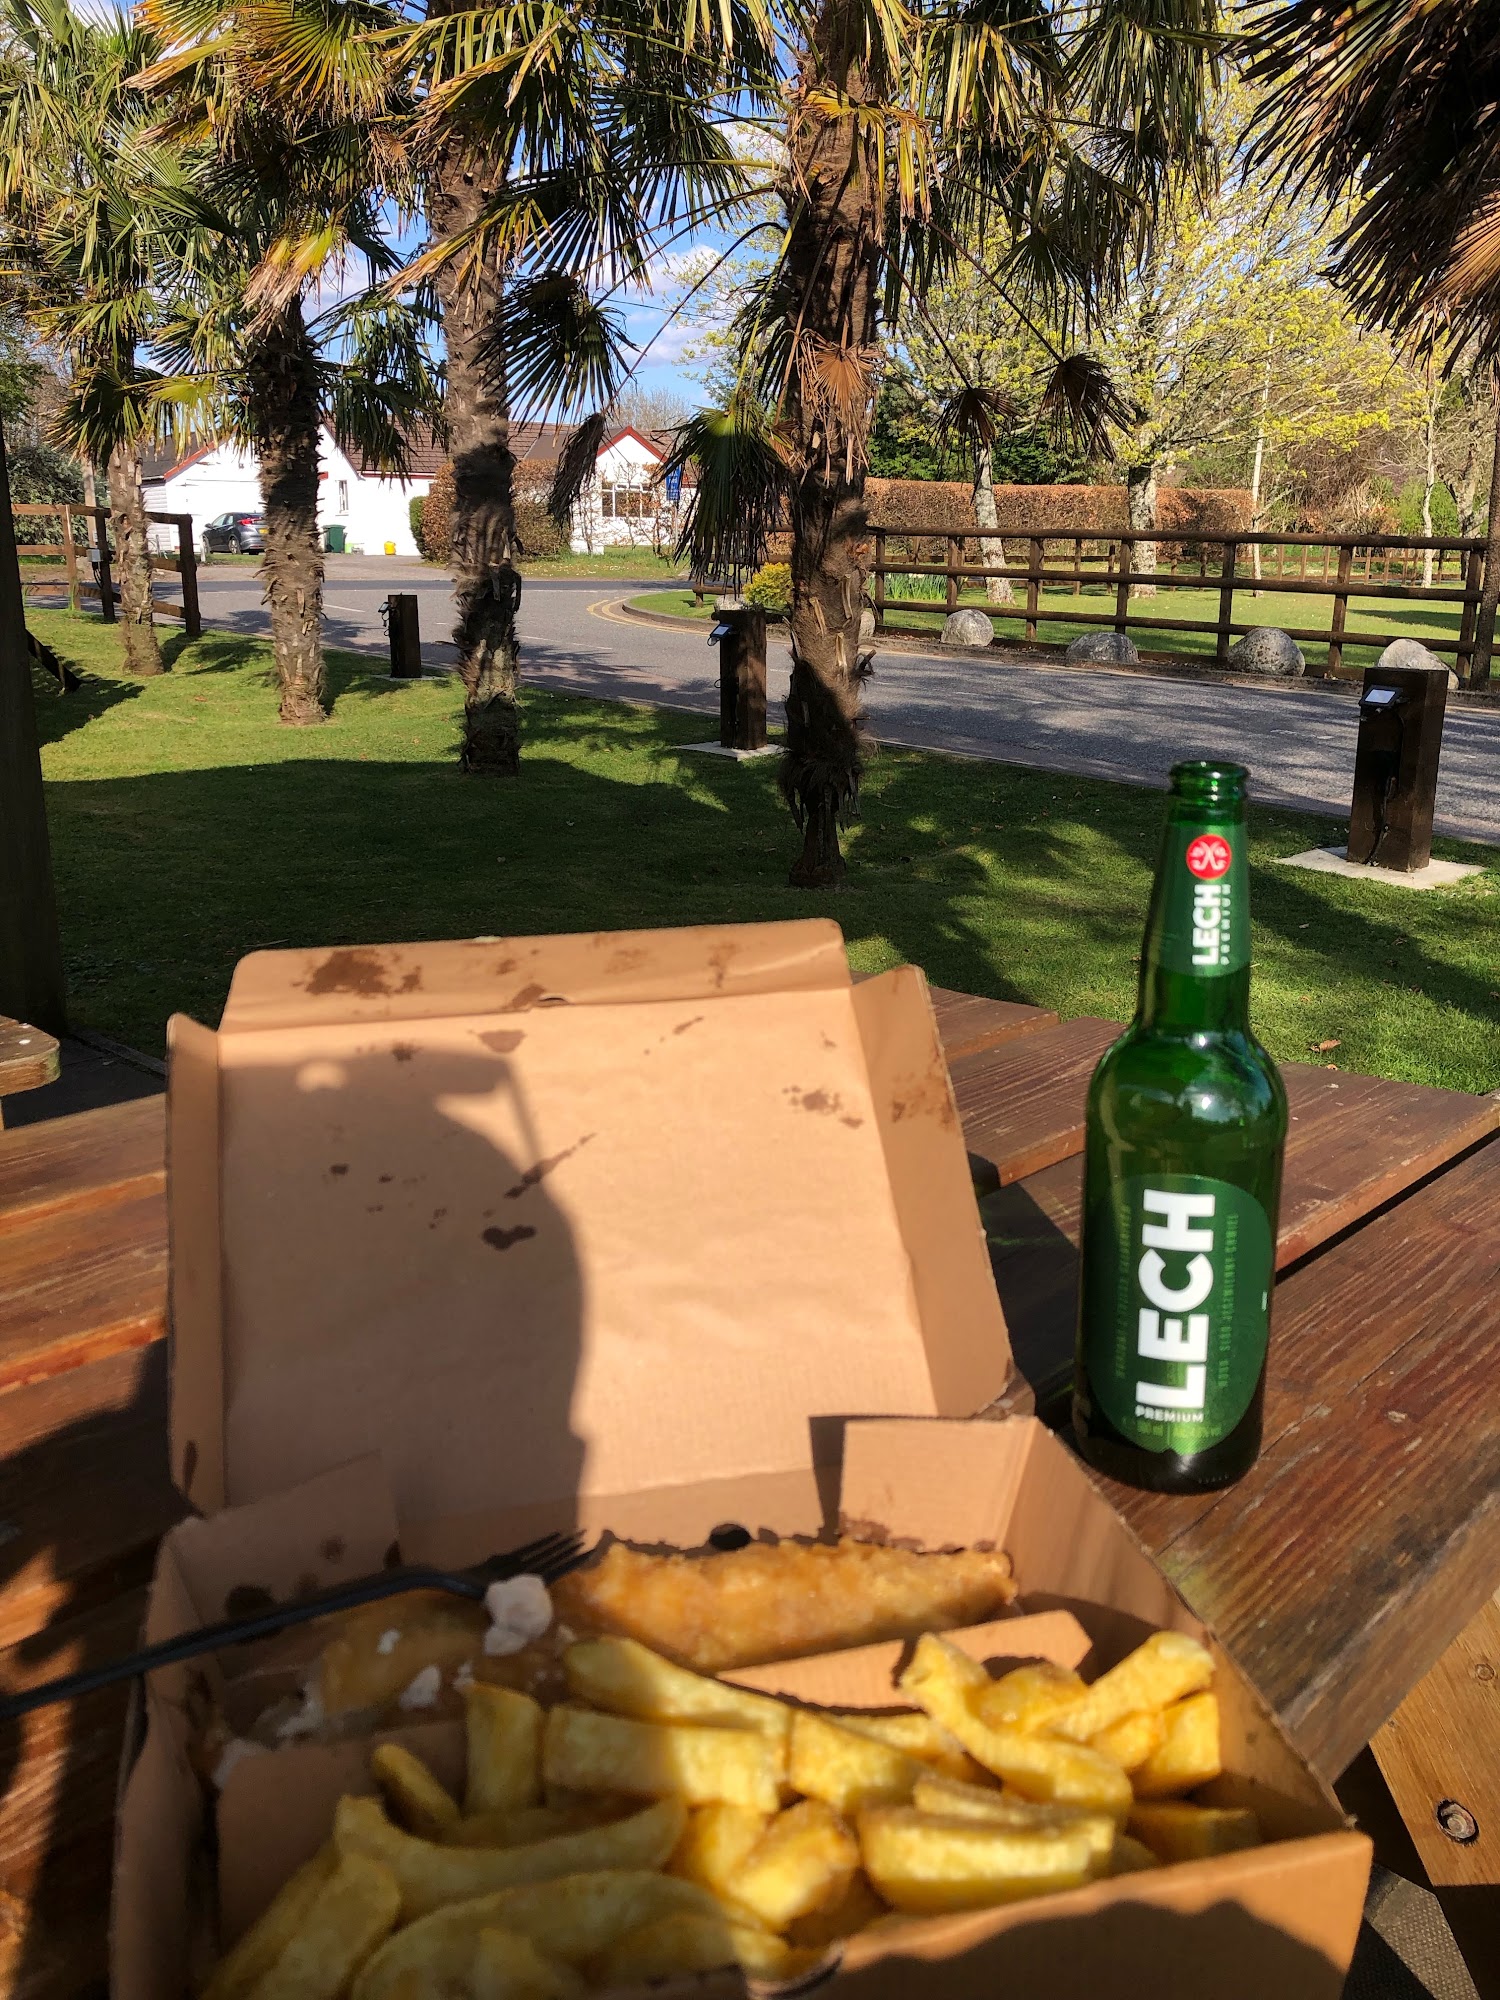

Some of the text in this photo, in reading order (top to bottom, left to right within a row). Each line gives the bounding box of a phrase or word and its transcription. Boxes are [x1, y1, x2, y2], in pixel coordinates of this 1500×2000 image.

[1192, 884, 1221, 965] LECH
[1136, 1188, 1216, 1409] LECH
[1135, 1404, 1204, 1423] PREMIUM
